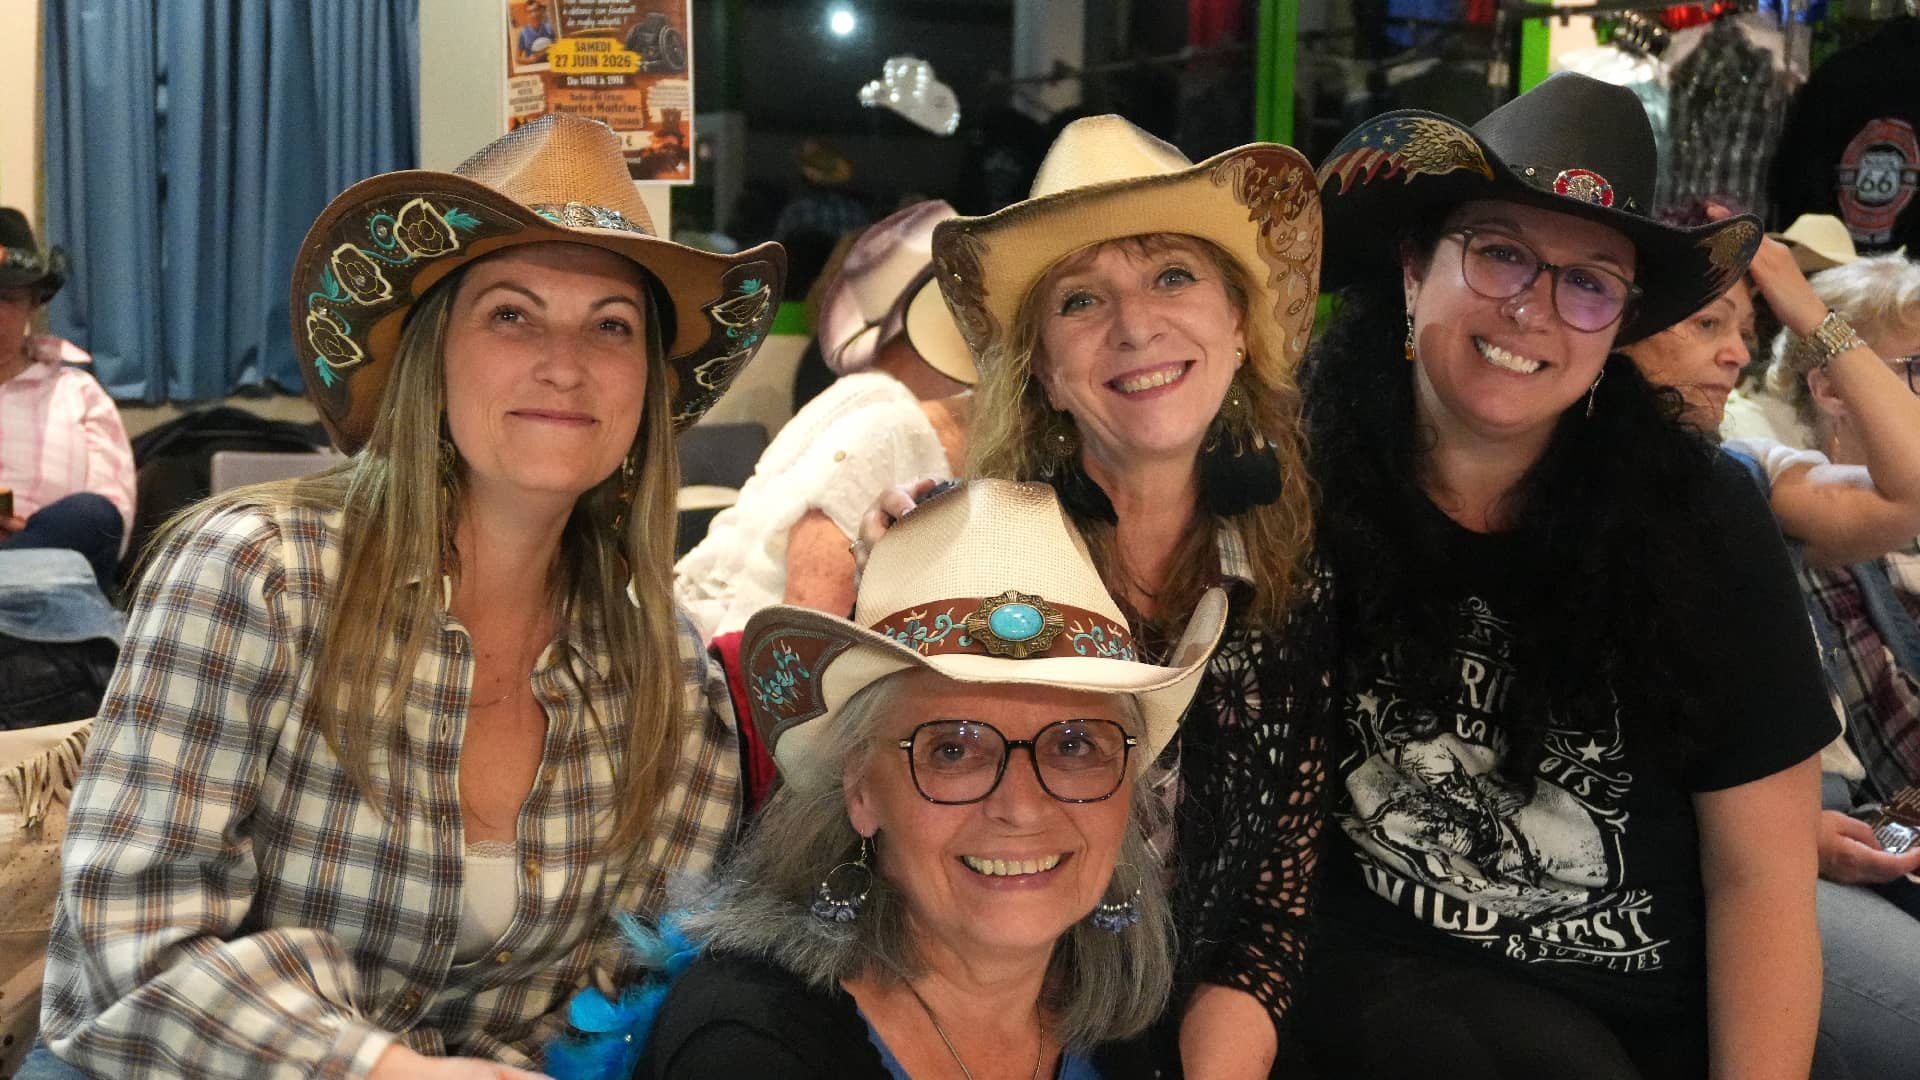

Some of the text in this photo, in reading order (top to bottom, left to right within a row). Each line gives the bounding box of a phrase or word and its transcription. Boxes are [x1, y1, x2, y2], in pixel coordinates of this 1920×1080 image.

[574, 41, 610, 52] SAMEDI
[555, 54, 631, 67] 27 JUIN 2026
[1859, 168, 1893, 193] 66
[1360, 864, 1499, 932] WILD
